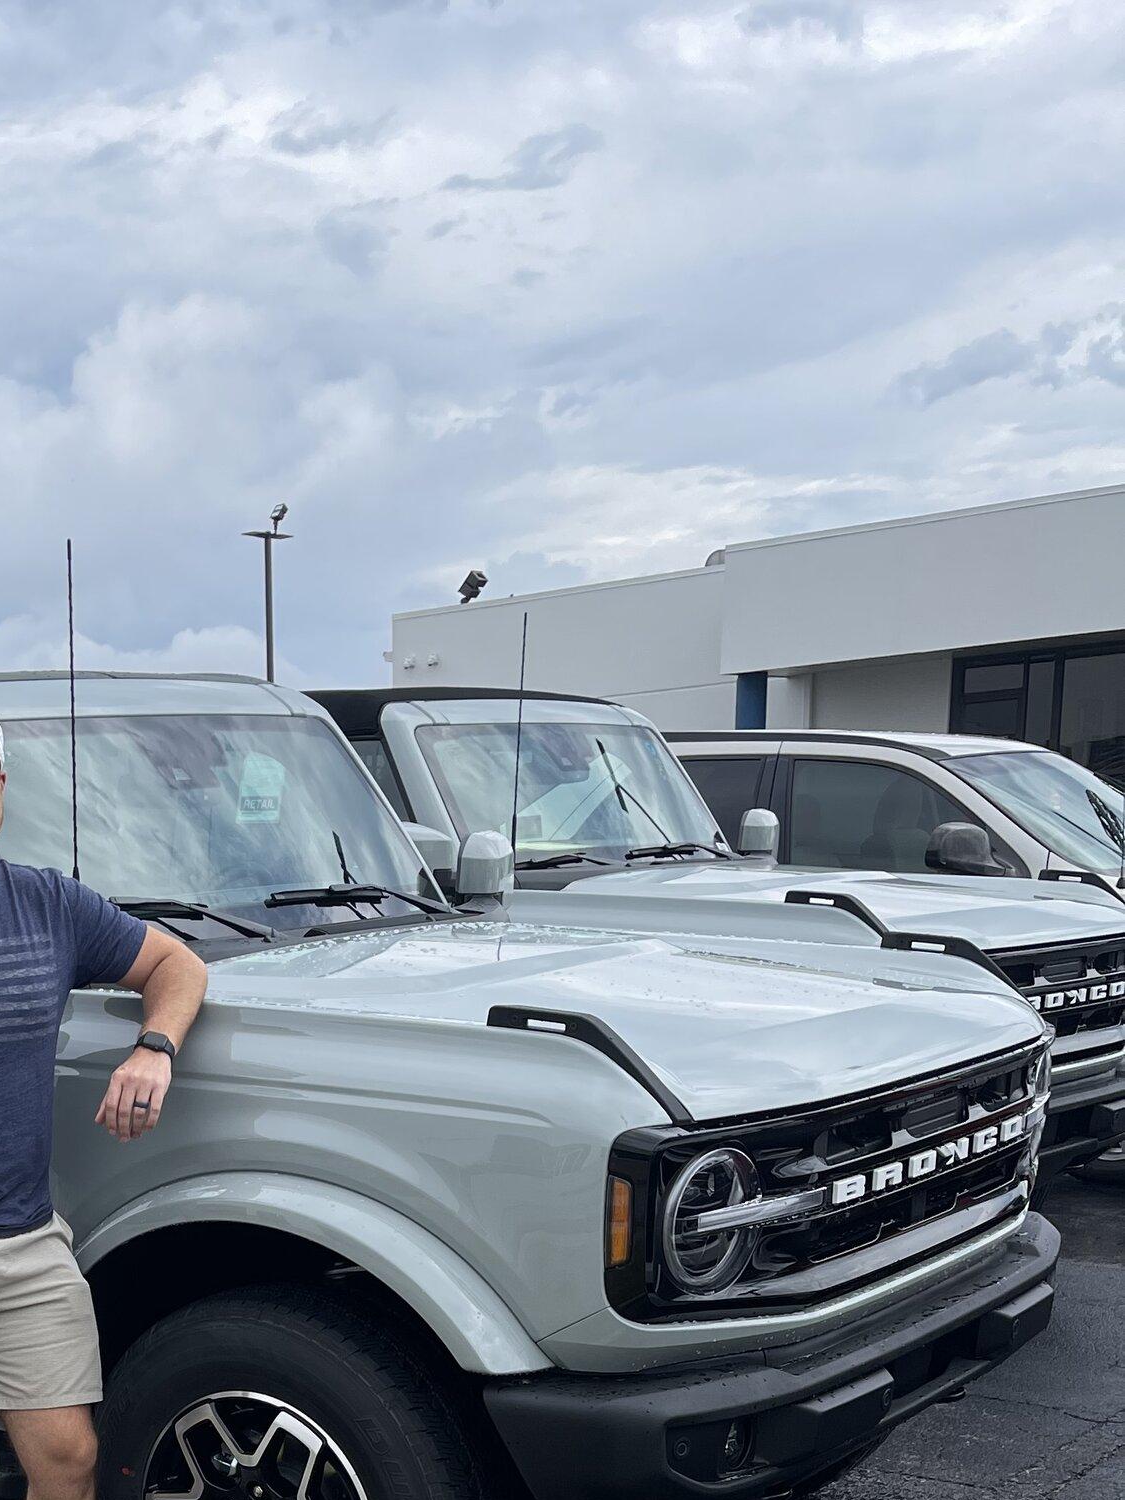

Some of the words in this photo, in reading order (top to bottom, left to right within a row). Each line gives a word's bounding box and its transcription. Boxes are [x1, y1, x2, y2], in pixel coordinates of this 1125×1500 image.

[243, 799, 275, 809] RETAIL
[1027, 981, 1125, 1010] RONCO
[832, 1114, 1024, 1204] BRONCO
